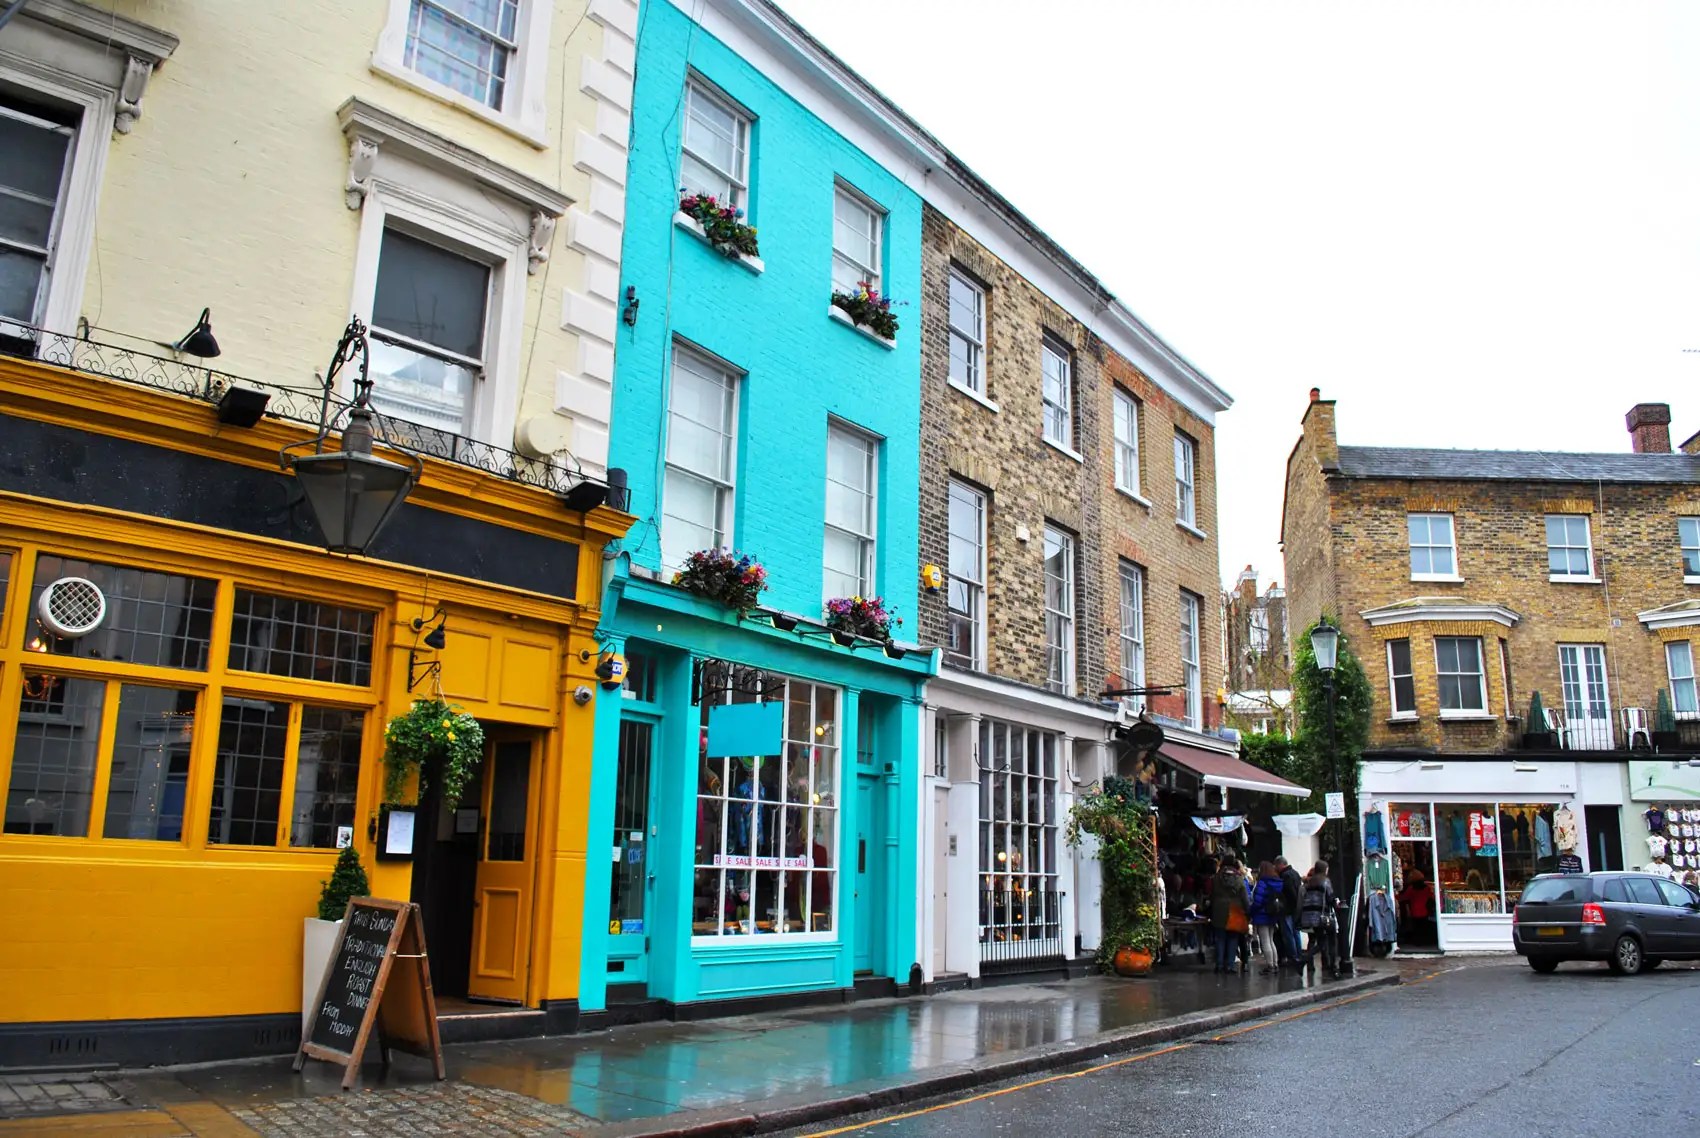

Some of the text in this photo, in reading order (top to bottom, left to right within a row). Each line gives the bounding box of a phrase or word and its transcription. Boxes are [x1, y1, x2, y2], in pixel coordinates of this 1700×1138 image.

[1471, 812, 1481, 847] SALE
[715, 856, 732, 865] SE
[736, 857, 752, 866] SALE
[756, 858, 772, 866] SALE
[794, 858, 807, 867] SAL
[353, 910, 369, 927] THIS
[344, 955, 377, 977] ENGLISH
[346, 973, 373, 993] ROAST
[321, 1001, 341, 1020] FROM
[329, 1020, 355, 1038] MIDDAY
